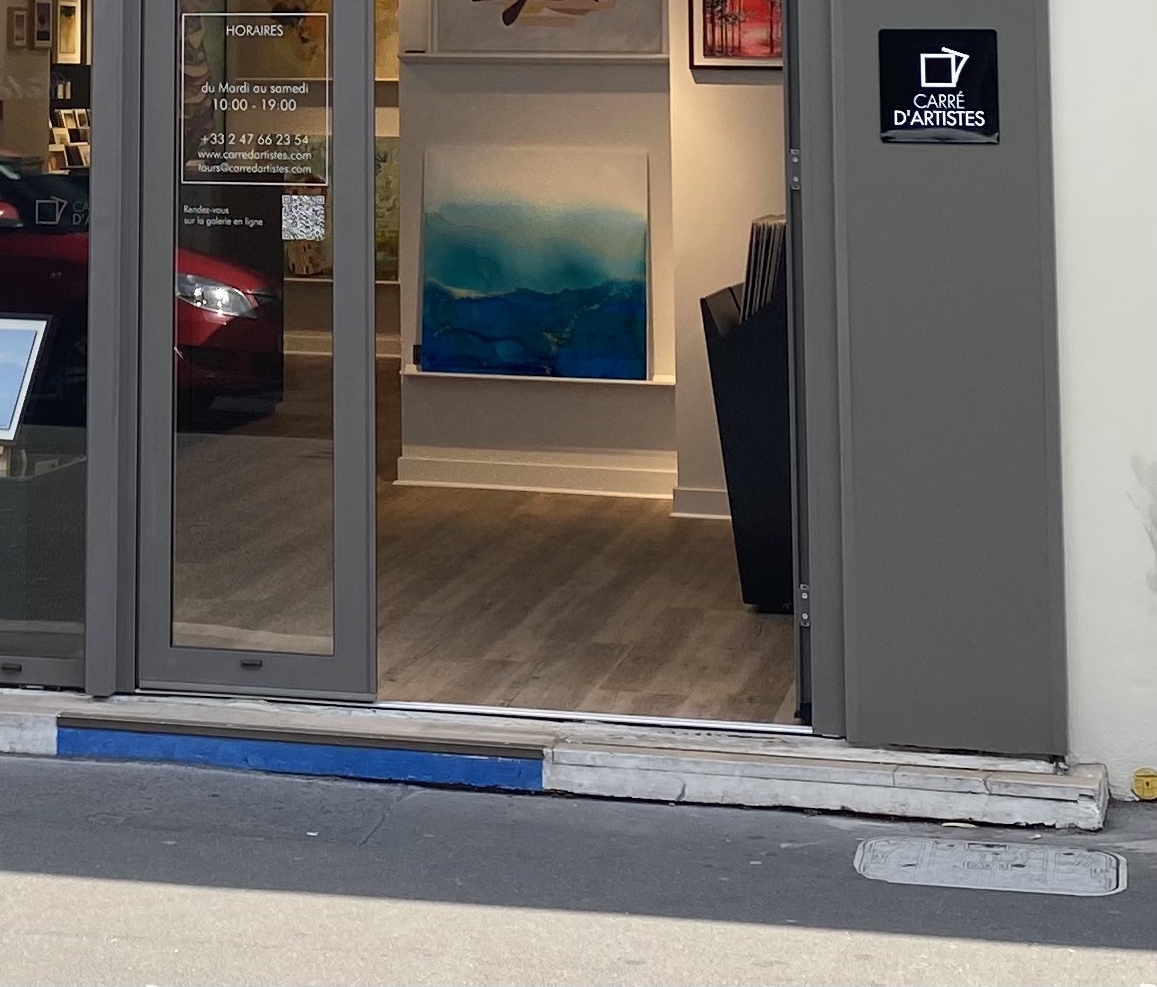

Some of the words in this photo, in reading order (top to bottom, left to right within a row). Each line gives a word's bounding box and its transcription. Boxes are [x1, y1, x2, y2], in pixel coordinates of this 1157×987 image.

[226, 24, 284, 37] HORAIRES
[201, 81, 215, 94] du
[218, 81, 250, 94] Mardi
[253, 85, 267, 94] au
[270, 81, 309, 94] samedi
[213, 98, 248, 111] 10:00
[261, 98, 297, 111] 19:00
[913, 91, 965, 109] CARRÉ
[893, 110, 986, 127] D'ARTISTES
[200, 133, 225, 145] +33
[228, 133, 235, 145] 2
[239, 133, 254, 145] 47
[257, 134, 273, 145] 66
[275, 134, 291, 145] 23
[294, 134, 309, 145] 54
[197, 149, 312, 160] www.carredartistes.com
[206, 216, 231, 227] galerie
